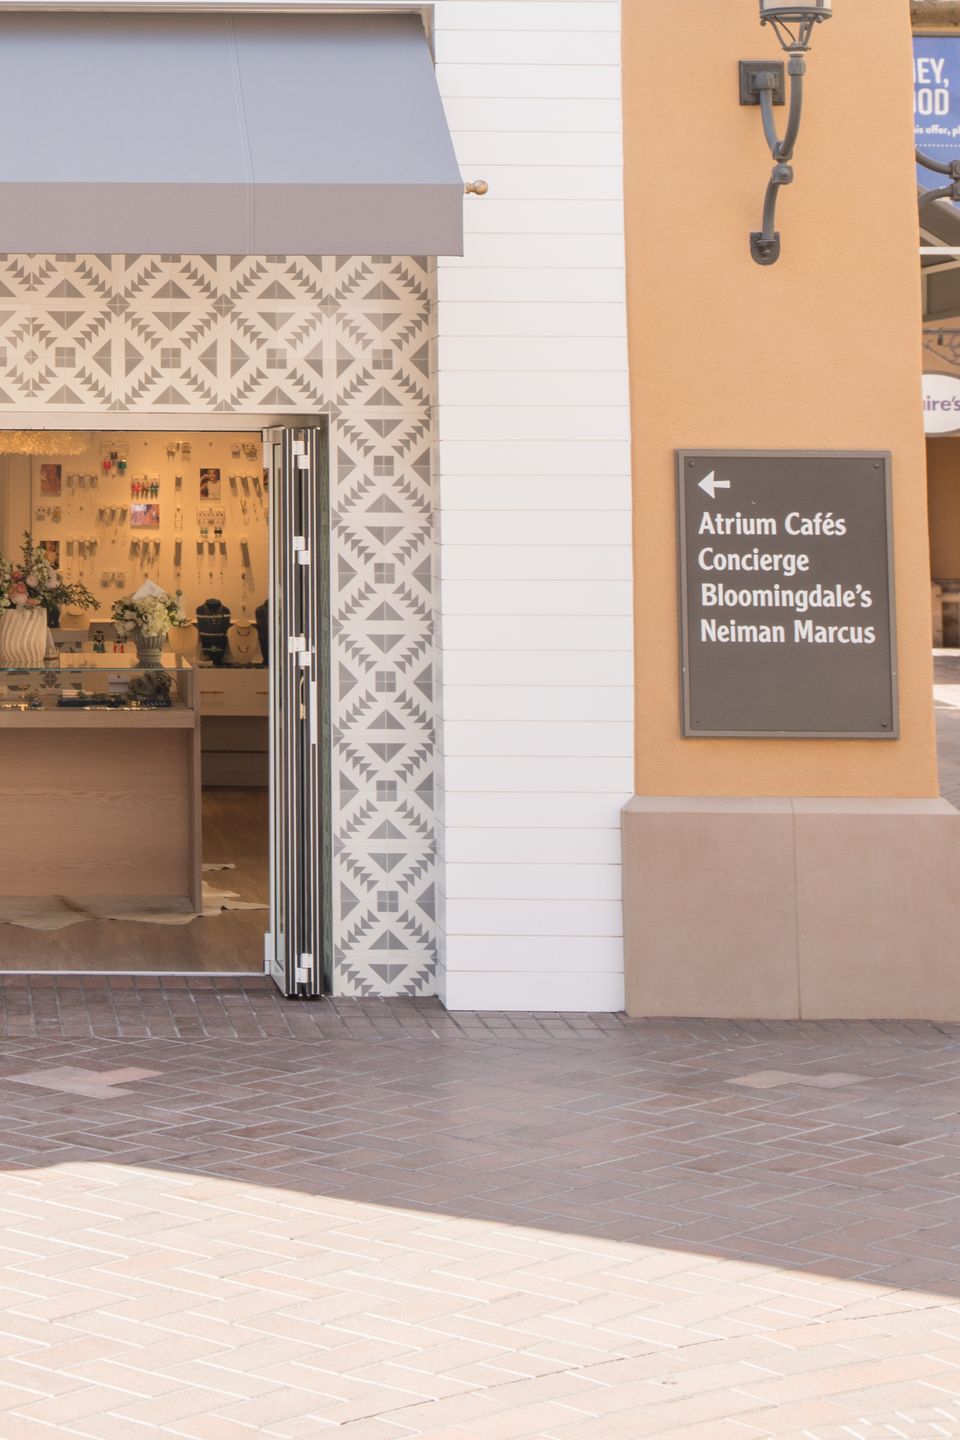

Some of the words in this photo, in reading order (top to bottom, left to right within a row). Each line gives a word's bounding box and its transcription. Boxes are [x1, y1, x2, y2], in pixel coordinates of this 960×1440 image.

[913, 57, 950, 88] EY,
[913, 88, 950, 116] OD
[925, 124, 950, 137] offer,
[923, 395, 960, 411] ire's
[698, 511, 777, 535] Atrium
[784, 511, 847, 536] Cafés
[698, 547, 810, 576] Concierge
[701, 583, 873, 612] Bloomingdale's
[700, 618, 785, 643] Neiman
[794, 619, 876, 644] Marcus
